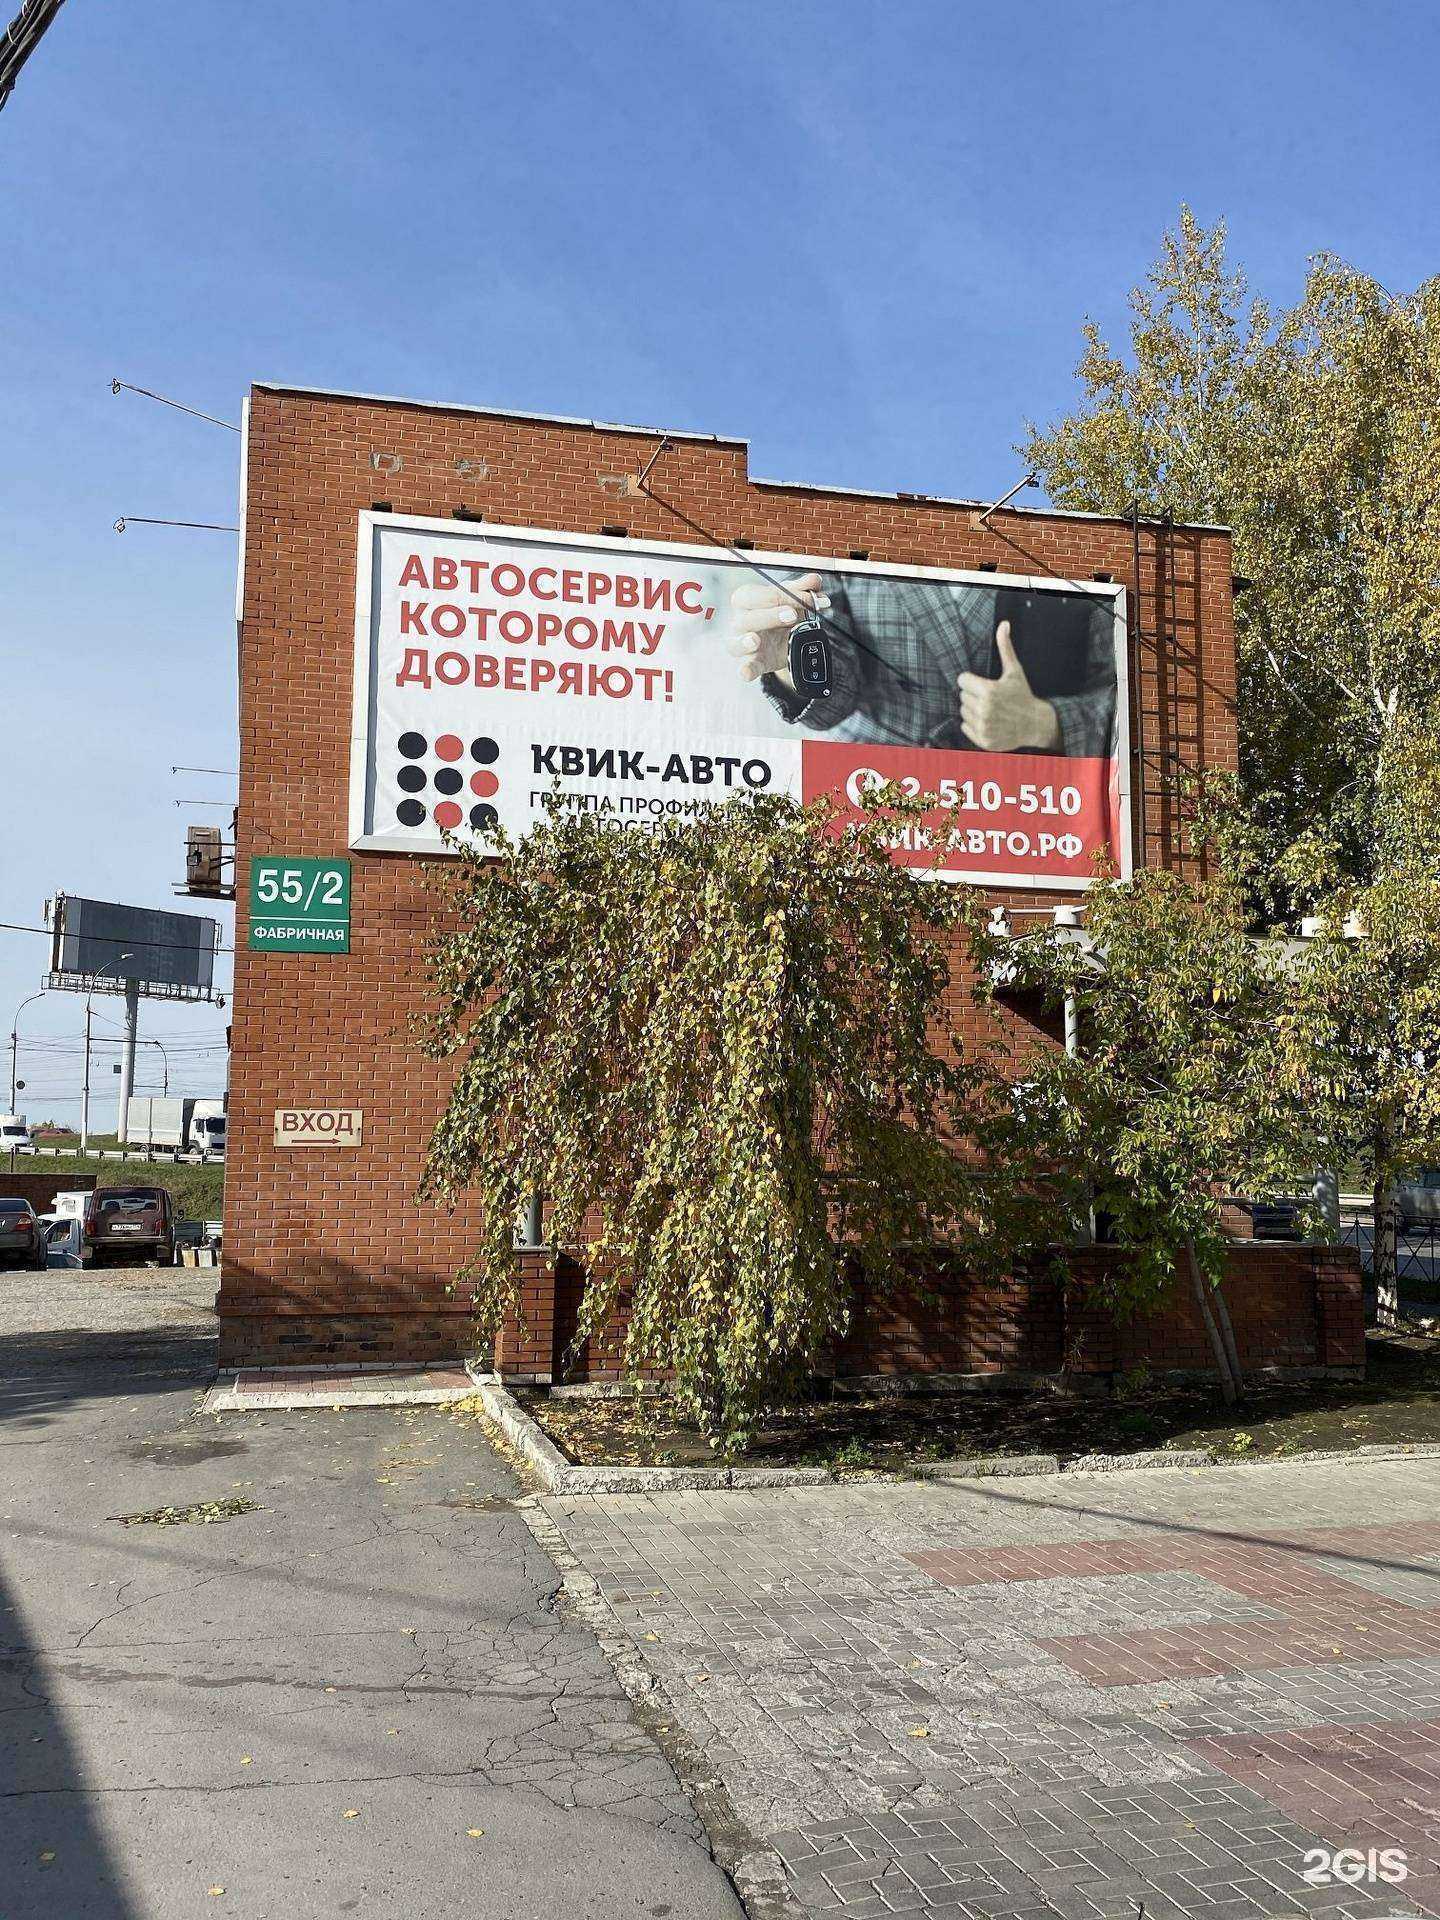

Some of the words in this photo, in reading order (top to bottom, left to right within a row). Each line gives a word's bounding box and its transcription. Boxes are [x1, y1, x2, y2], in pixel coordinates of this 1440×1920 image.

[398, 554, 715, 620] АВТОСЕРВИС,
[400, 600, 666, 656] КОТОРОМУ
[396, 648, 673, 702] ДОВЕРЯЮТ!
[531, 744, 771, 788] КВИК-АВТО
[257, 868, 343, 911] 55/2
[254, 926, 345, 941] ФАБРИЧНАЯ
[282, 1112, 353, 1135] ВХОД
